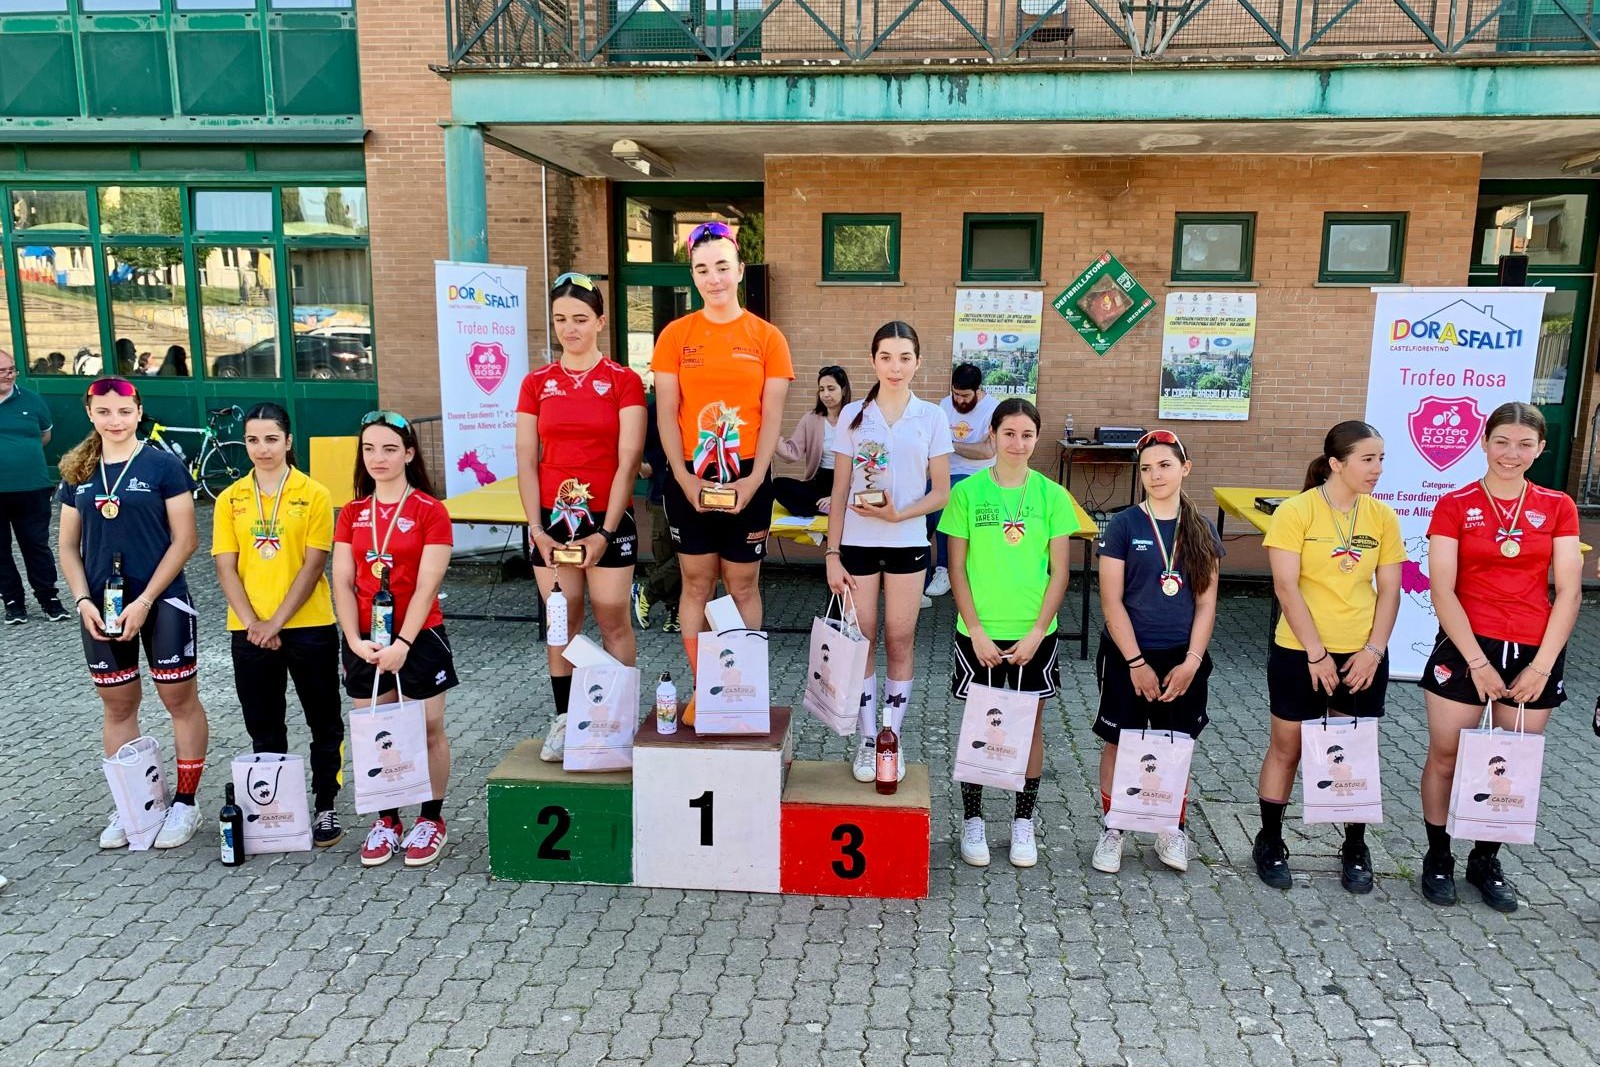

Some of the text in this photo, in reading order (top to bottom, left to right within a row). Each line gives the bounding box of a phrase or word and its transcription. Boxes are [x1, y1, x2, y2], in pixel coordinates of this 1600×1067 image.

[1054, 258, 1106, 310] DEFIBRILLATORE
[449, 285, 519, 309] DORASFALTI
[457, 321, 516, 336] Trofeo Rosa
[1390, 319, 1523, 349] DORASFALTI
[1400, 368, 1506, 387] Trofeo Rosa
[1171, 388, 1193, 397] COPPA
[1221, 389, 1227, 398] DI
[467, 411, 495, 419] Esordienti
[1422, 427, 1469, 436] trofeo
[1421, 436, 1467, 444] ROSA
[1422, 481, 1457, 490] Categorie:
[1370, 492, 1394, 501] onne
[975, 514, 999, 522] VARESE
[1465, 521, 1485, 529] LIVIA
[689, 791, 714, 846] 1
[536, 805, 571, 861] 2
[831, 823, 866, 879] 3
